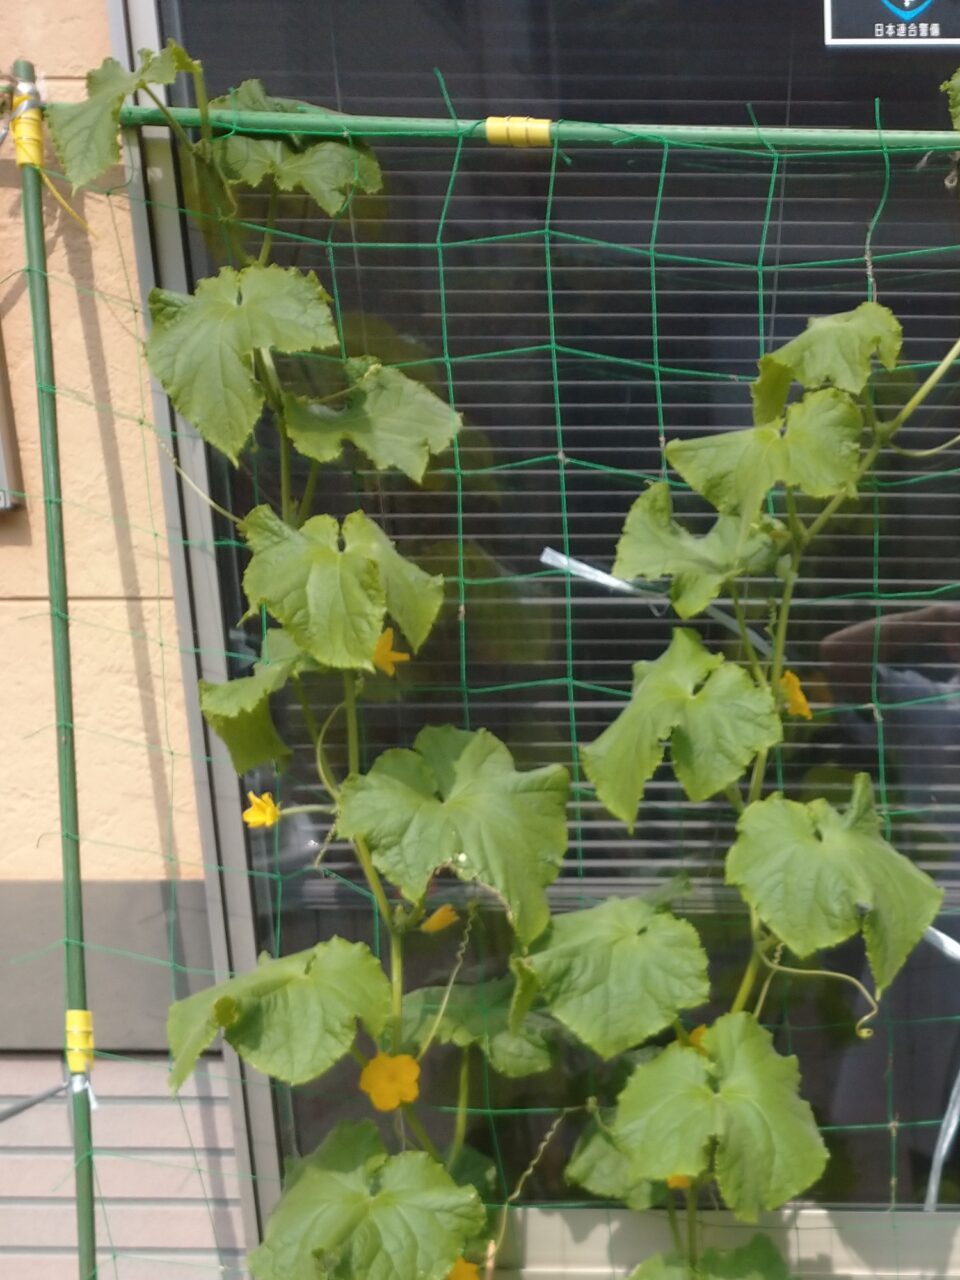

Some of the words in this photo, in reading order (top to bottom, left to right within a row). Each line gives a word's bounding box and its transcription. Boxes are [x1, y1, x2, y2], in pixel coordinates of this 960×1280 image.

[874, 22, 941, 37] 日本連合警備
